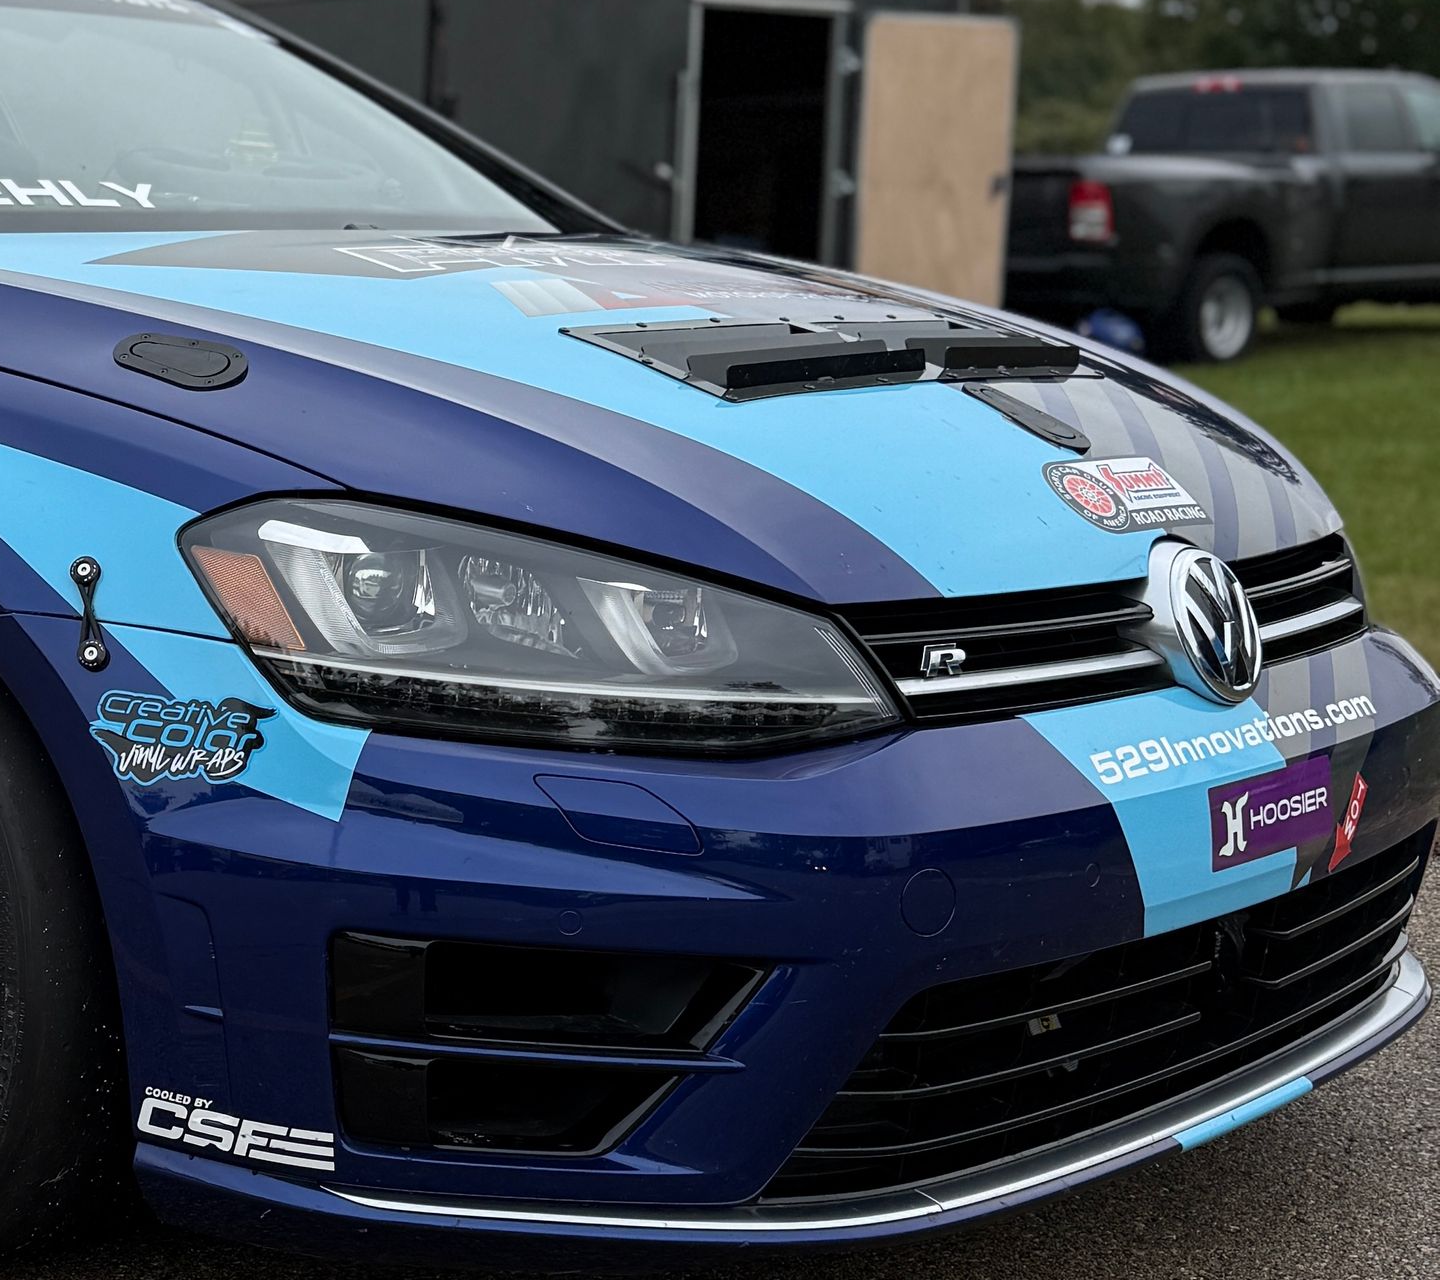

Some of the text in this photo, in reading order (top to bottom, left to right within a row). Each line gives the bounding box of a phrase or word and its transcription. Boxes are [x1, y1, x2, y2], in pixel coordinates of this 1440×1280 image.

[1131, 506, 1206, 525] ROAD RACING
[1089, 695, 1377, 785] 529Innovations.com
[1249, 786, 1328, 830] HOOSIER
[1344, 779, 1364, 841] TOW
[145, 1086, 213, 1109] COOLED BY
